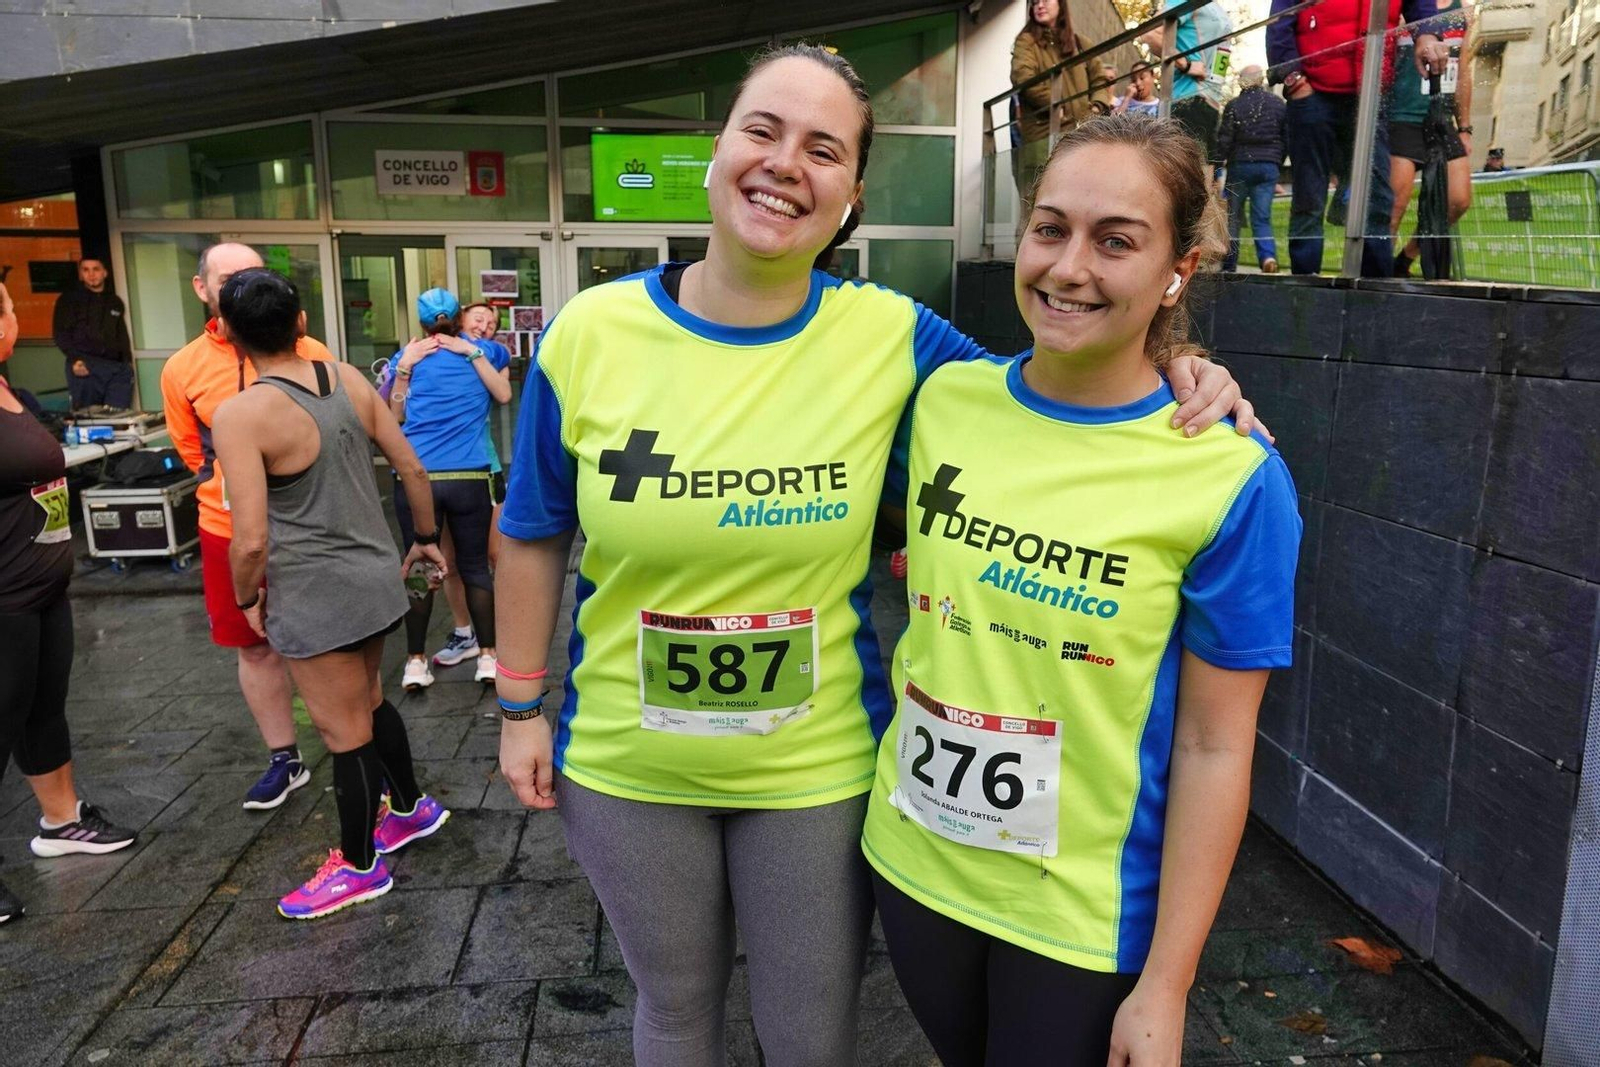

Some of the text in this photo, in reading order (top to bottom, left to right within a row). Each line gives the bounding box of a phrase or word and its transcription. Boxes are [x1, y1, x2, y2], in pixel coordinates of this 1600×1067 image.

[383, 159, 458, 172] CONCELLO
[393, 174, 450, 186] DE VIGO
[660, 462, 848, 499] DEPORTE
[717, 497, 849, 528] Atlántico
[943, 511, 1130, 587] DEPORTE
[978, 560, 1119, 619] Atlántico
[989, 622, 1013, 638] máis
[1022, 633, 1047, 650] auga
[1062, 641, 1089, 653] RUN
[668, 639, 790, 695] 587
[1002, 720, 1026, 728] CONCELLO
[911, 725, 1024, 811] 276
[941, 802, 969, 817] ABALDE
[970, 811, 1003, 824] ORTEGA
[331, 884, 347, 894] FILA
